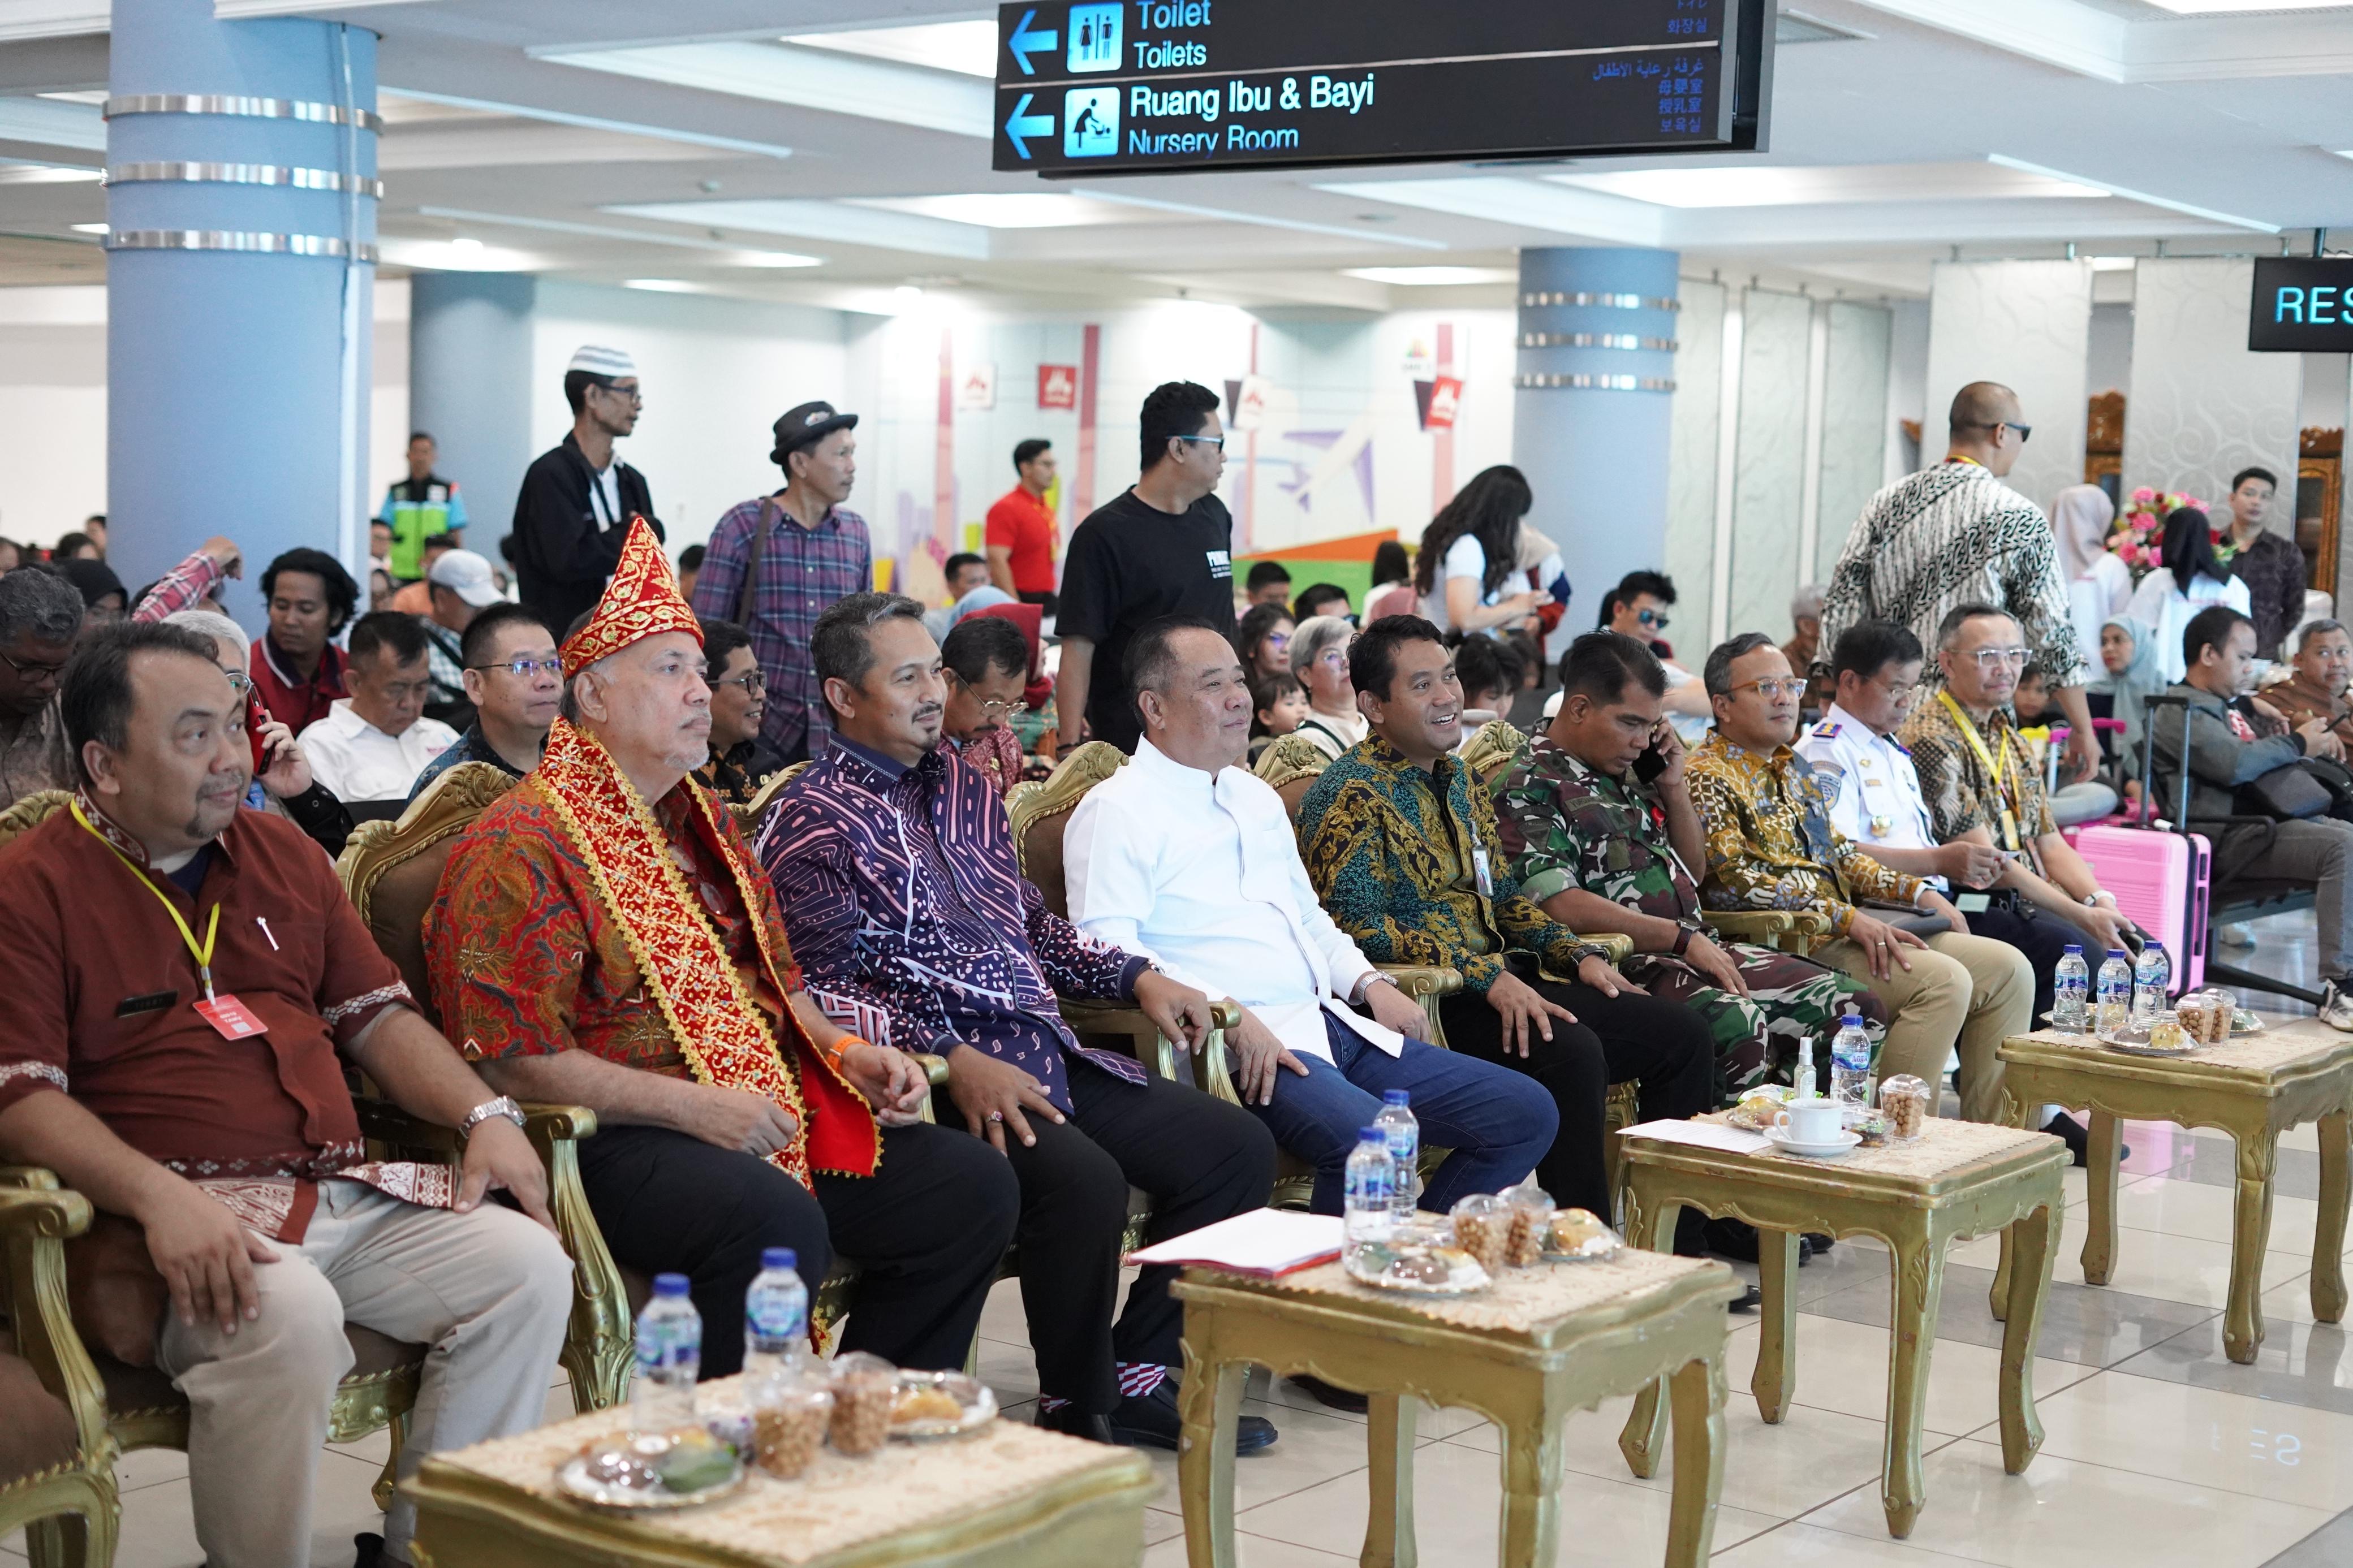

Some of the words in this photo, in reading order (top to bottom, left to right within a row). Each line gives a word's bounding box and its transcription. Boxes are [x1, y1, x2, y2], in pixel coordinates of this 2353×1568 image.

[1136, 0, 1212, 29] Toilet
[1667, 18, 1708, 34] 화장실
[1133, 40, 1207, 68] Toilets
[1131, 85, 1220, 122] Ruang
[1229, 80, 1271, 113] Ibu
[1279, 77, 1301, 110] &
[1311, 72, 1374, 114] Bayi
[1128, 128, 1219, 159] Nursery
[1227, 124, 1299, 151] Room
